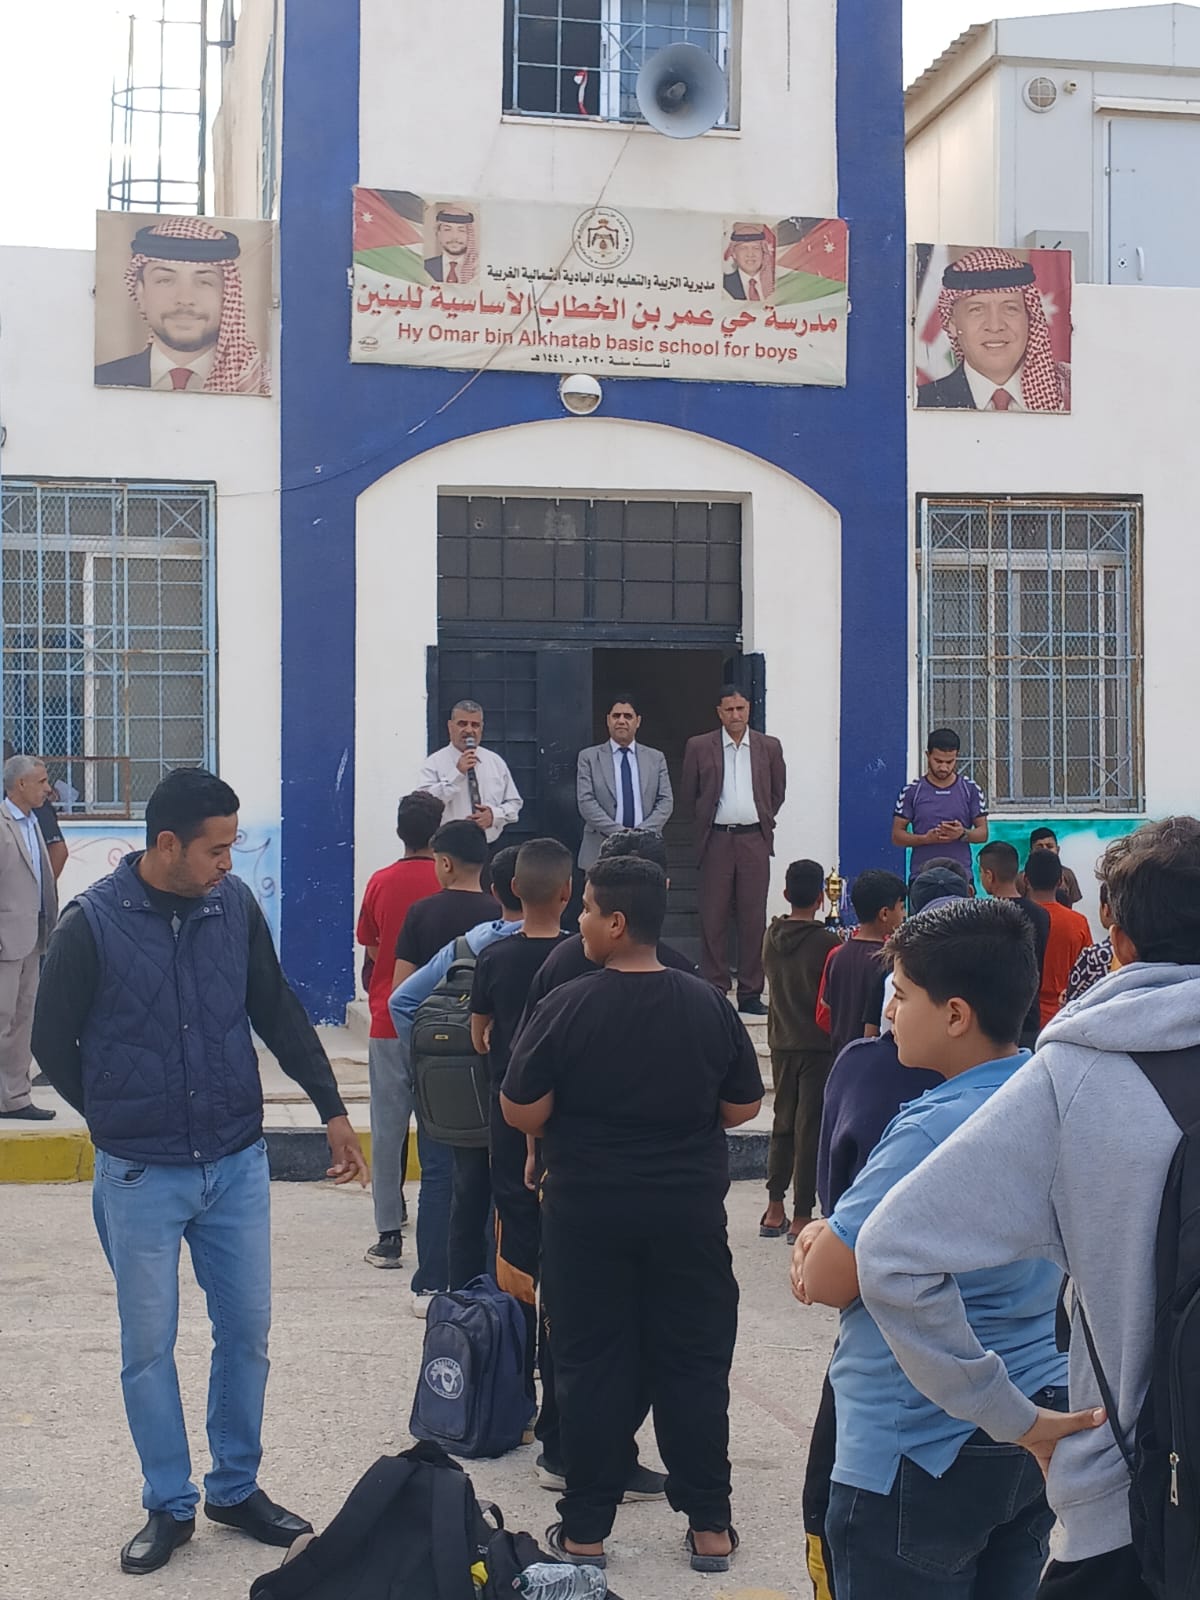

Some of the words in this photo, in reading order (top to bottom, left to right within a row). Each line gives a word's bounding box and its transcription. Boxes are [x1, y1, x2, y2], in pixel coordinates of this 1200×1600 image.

[487, 264, 519, 282] الغربية
[521, 266, 561, 283] الشمالية
[563, 269, 593, 286] البادية
[616, 273, 651, 290] والتعليم
[653, 275, 681, 291] التربية
[683, 277, 715, 293] مديرية
[357, 282, 423, 315] للبنين
[430, 283, 533, 319] الأساسية
[539, 293, 626, 325] الخطاب
[631, 301, 661, 331] بن
[664, 309, 714, 331] عمر
[721, 311, 756, 338] حي
[764, 305, 838, 337] مدرسة
[398, 322, 423, 344] Hy
[428, 324, 480, 343] Omar
[485, 327, 513, 344] bin
[519, 329, 601, 350] Alkhatab
[606, 334, 654, 353] basic
[659, 338, 719, 357] school
[723, 341, 750, 358] for
[755, 342, 798, 364] boys
